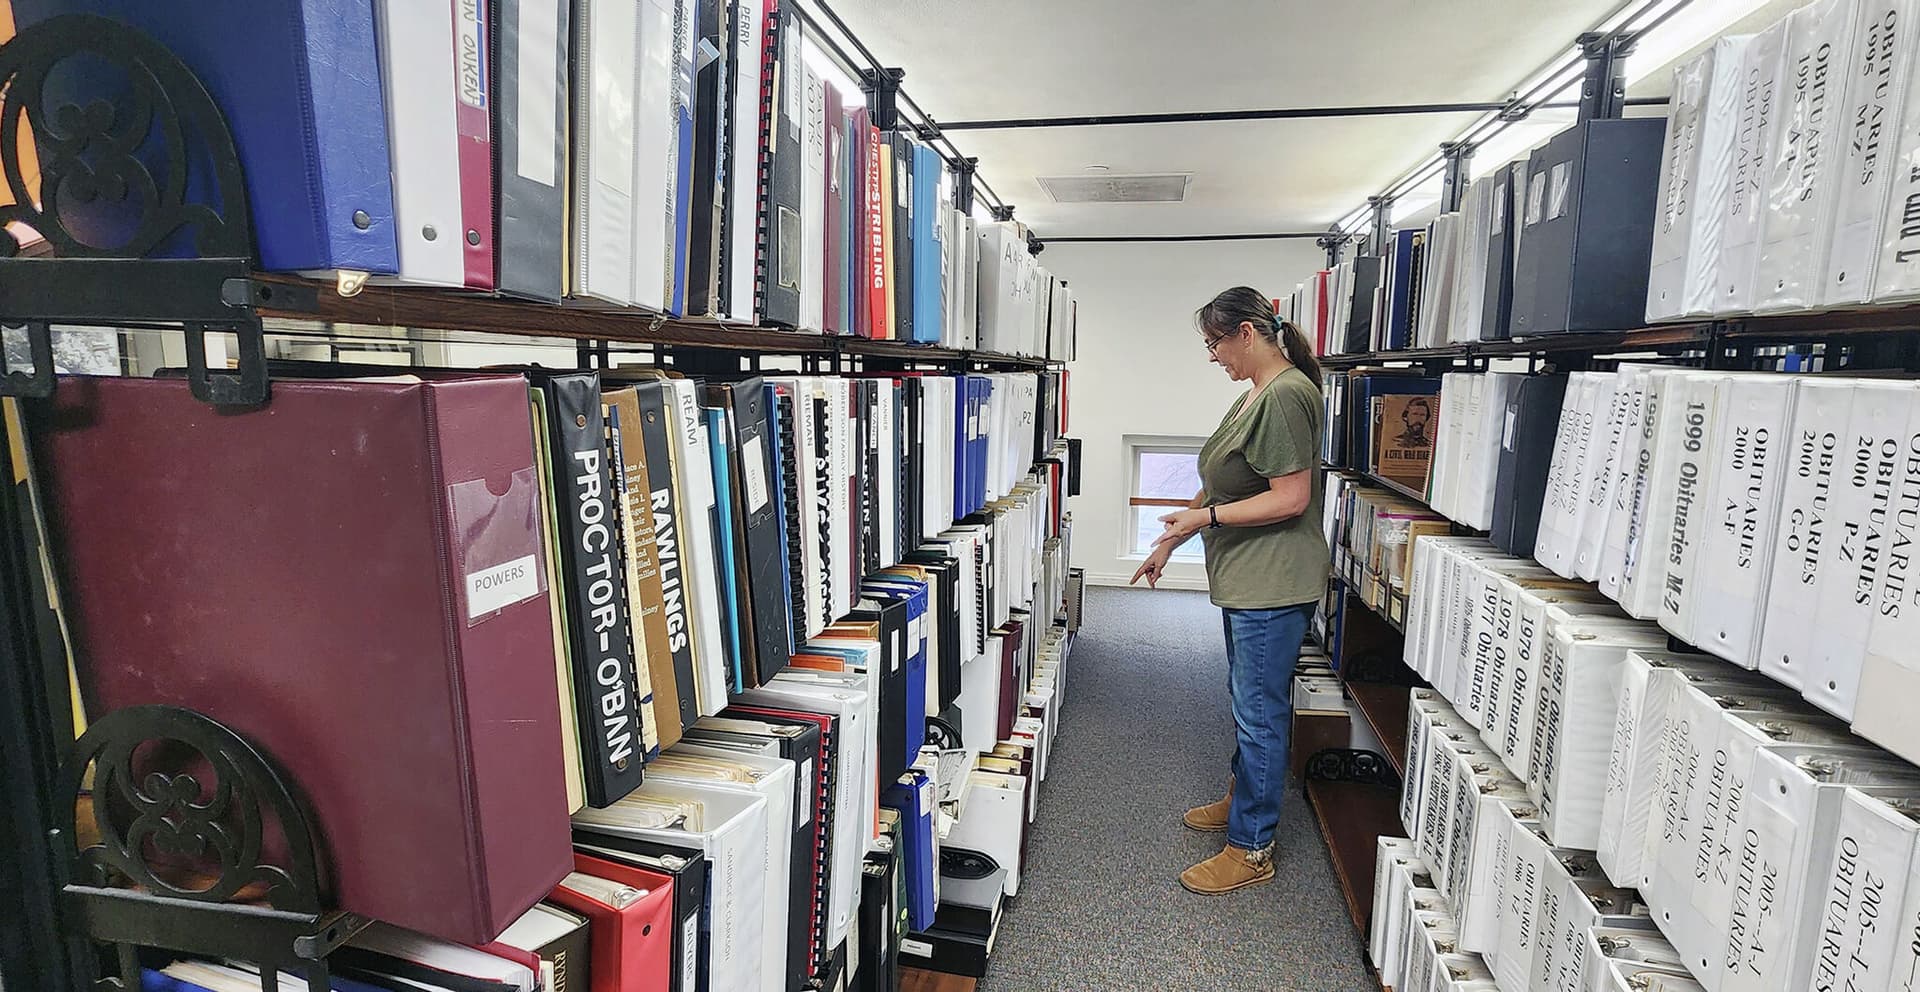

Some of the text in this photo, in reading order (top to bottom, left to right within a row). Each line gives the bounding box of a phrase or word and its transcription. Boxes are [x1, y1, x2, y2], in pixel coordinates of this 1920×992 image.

[740, 5, 751, 48] PERRY
[1793, 54, 1810, 104] 1995
[1800, 42, 1831, 203] OBITUARIES
[1850, 22, 1880, 158] 1995 M-Z
[1861, 9, 1898, 187] OBITUARIES
[1731, 67, 1760, 217] OBITUARIES
[872, 190, 884, 289] STRIBLING
[682, 394, 698, 446] REAM
[1022, 411, 1031, 424] PZ
[1551, 409, 1575, 507] OBITUARIES
[1596, 392, 1629, 508] OBITUARIES
[1630, 390, 1642, 428] 1973
[1643, 392, 1658, 440] 1999
[1568, 412, 1592, 516] OBITUARIES
[1629, 449, 1651, 545] Obituaries
[1664, 402, 1706, 616] 1999 Obituaries M-Z
[1724, 426, 1749, 535] 2000 A-F
[1737, 428, 1769, 569] OBITUARIES
[1787, 430, 1816, 552] 2000 G-O
[1801, 432, 1836, 585] OBITUARIES
[1839, 436, 1873, 562] 2000 P-Z
[650, 488, 687, 653] RAWLINGS
[1855, 439, 1898, 606] OBITUARIES
[474, 565, 525, 592] POWERS
[1469, 583, 1498, 712] 1977 Obituaries
[1486, 597, 1512, 732] 1978 Obituaries
[1505, 614, 1534, 758] 1979 Obituaries
[1552, 654, 1564, 696] 1981
[1531, 630, 1554, 784] 1980 Obituaries
[1544, 699, 1560, 784] Obituaries
[1425, 774, 1440, 838] OBITUARIES
[1436, 784, 1449, 849] OBITUARIES
[1442, 755, 1452, 782] 1983
[1456, 774, 1467, 815] 1984
[1664, 719, 1689, 844] OBITUARIES
[1695, 749, 1728, 884] OBITUARIES
[1514, 855, 1524, 883] 1986
[1520, 863, 1536, 951] OBITUARIES
[1542, 886, 1551, 917] 1987
[1726, 828, 1760, 975] OBITUARIES
[1815, 836, 1860, 992] OBITUARIES
[1543, 894, 1559, 985] OBITUARIES
[1564, 920, 1576, 953] 1987
